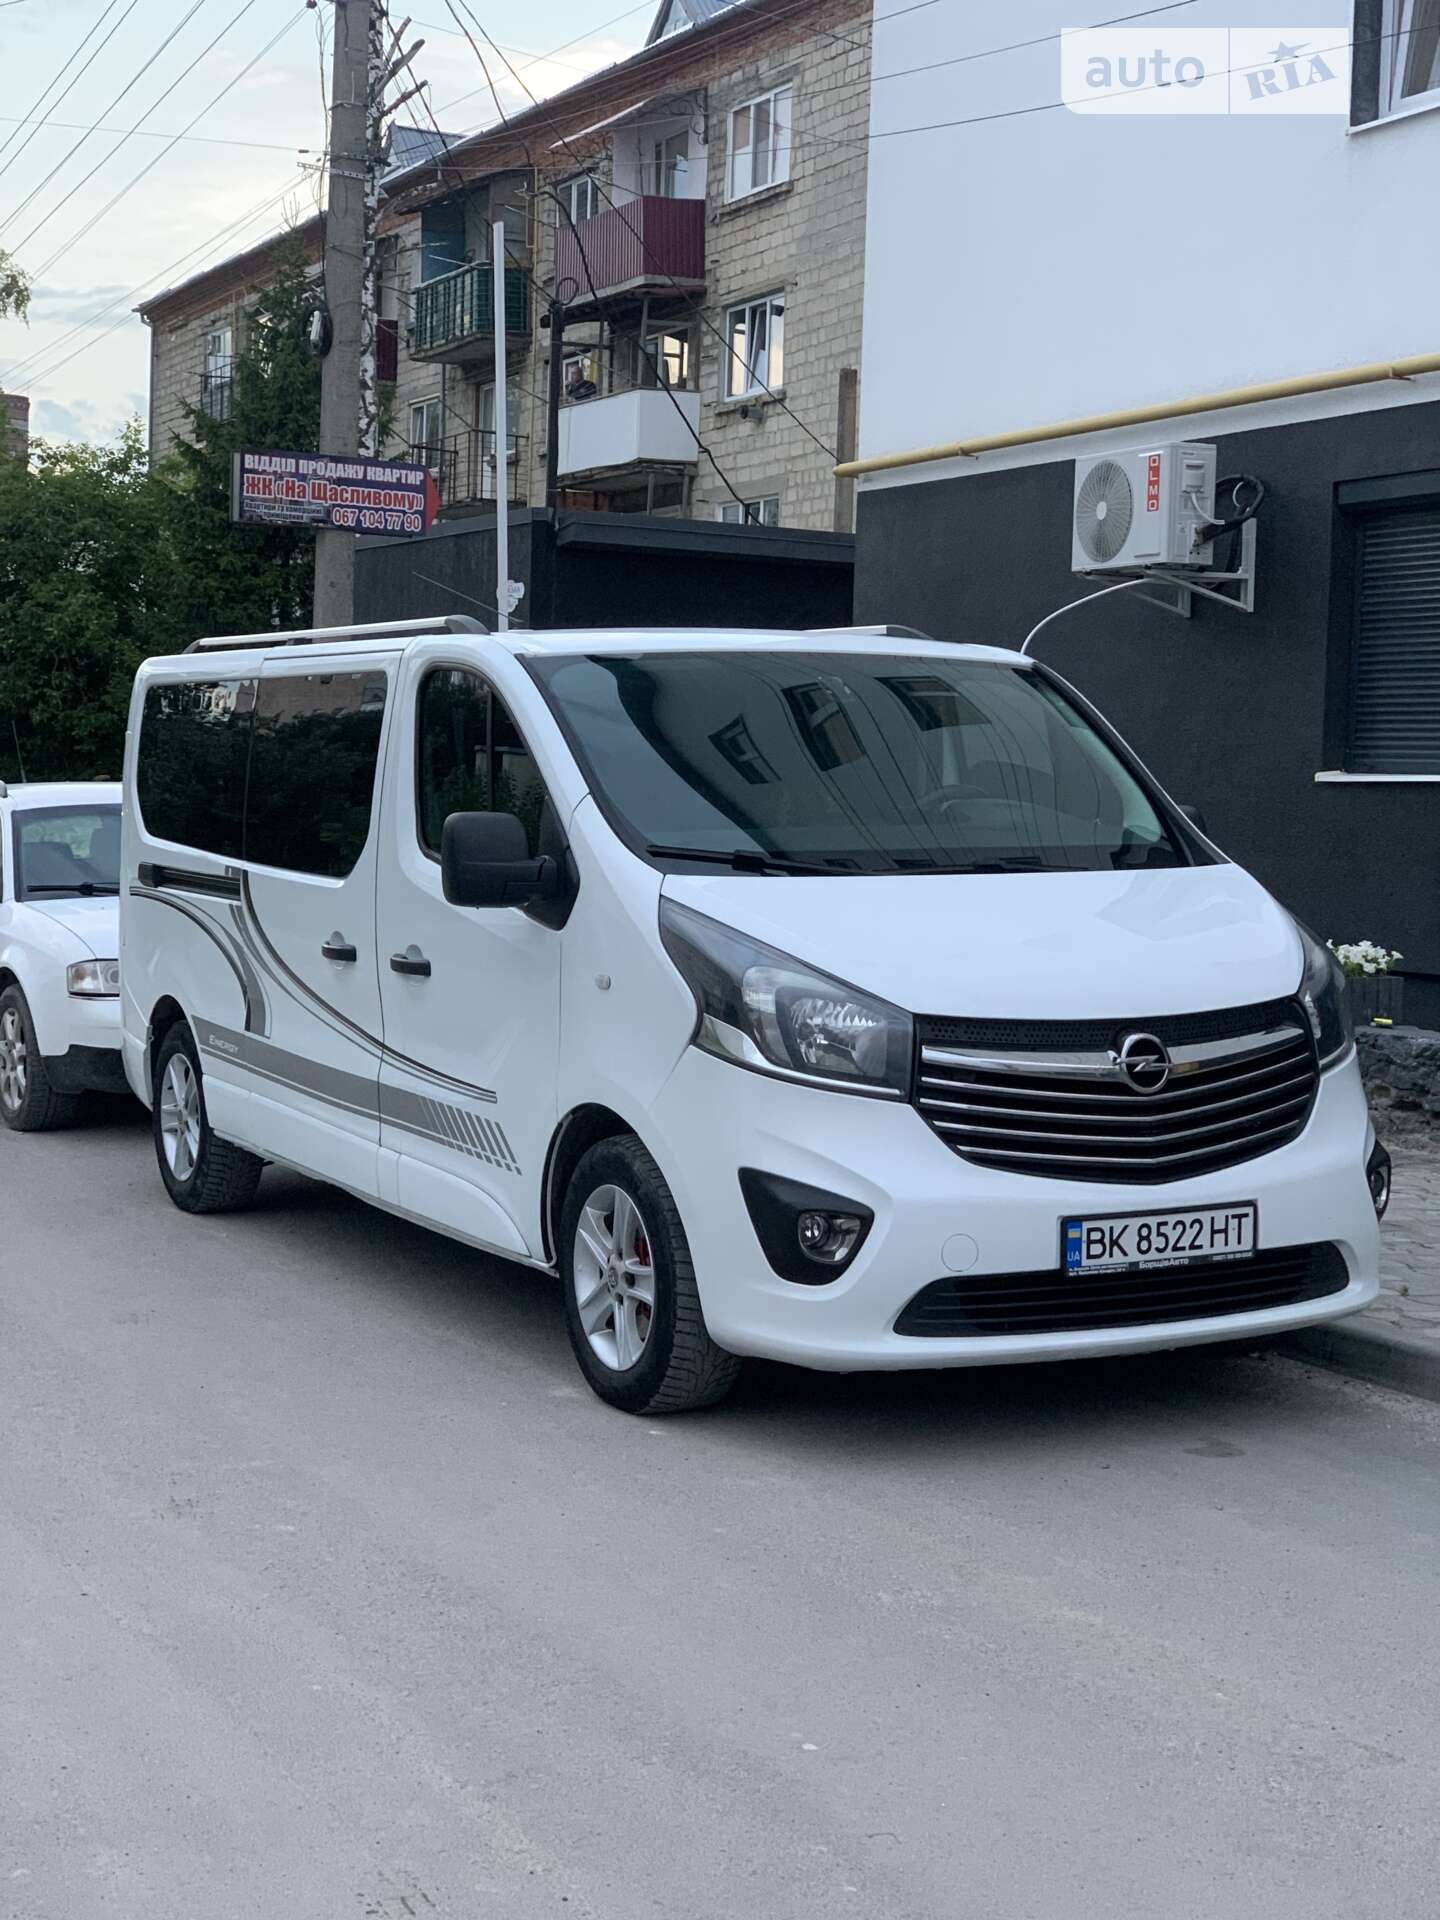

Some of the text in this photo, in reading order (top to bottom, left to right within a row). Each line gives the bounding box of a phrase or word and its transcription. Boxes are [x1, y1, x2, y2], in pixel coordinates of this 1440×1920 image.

[244, 453, 424, 485] ВІДДІЛ ПРОДАЖУ КВАРТИР
[1149, 456, 1159, 511] OLMO
[243, 474, 275, 497] ЖК
[310, 480, 424, 512] Щасливому»
[333, 507, 422, 532] 067 104 77 90
[1086, 1213, 1250, 1260] BK 8522 HT
[1067, 1250, 1081, 1262] UA
